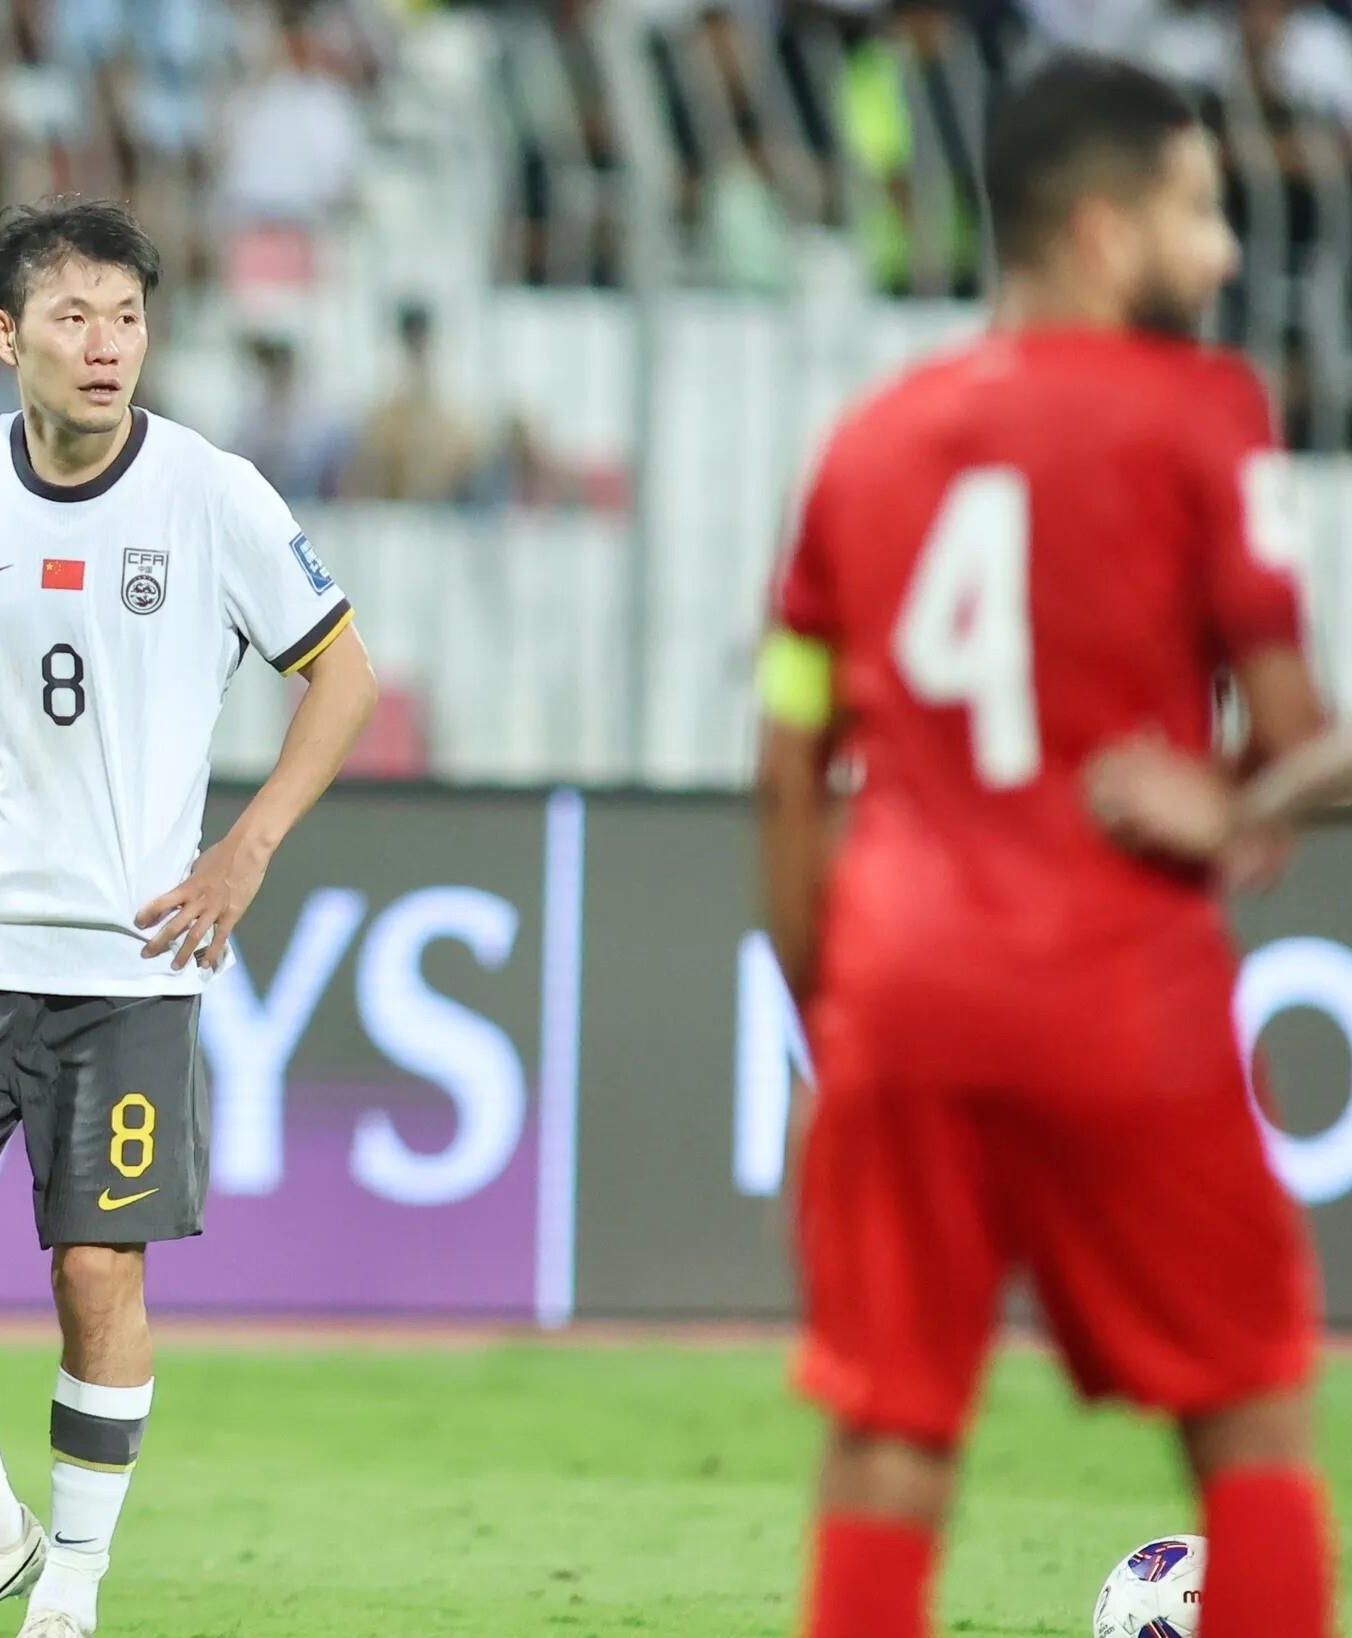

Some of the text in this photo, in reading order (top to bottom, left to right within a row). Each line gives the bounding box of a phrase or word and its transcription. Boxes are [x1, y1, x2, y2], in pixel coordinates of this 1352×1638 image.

[128, 552, 164, 566] CFA
[890, 463, 1043, 790] 4
[41, 643, 85, 726] 8
[109, 1092, 156, 1178] 8
